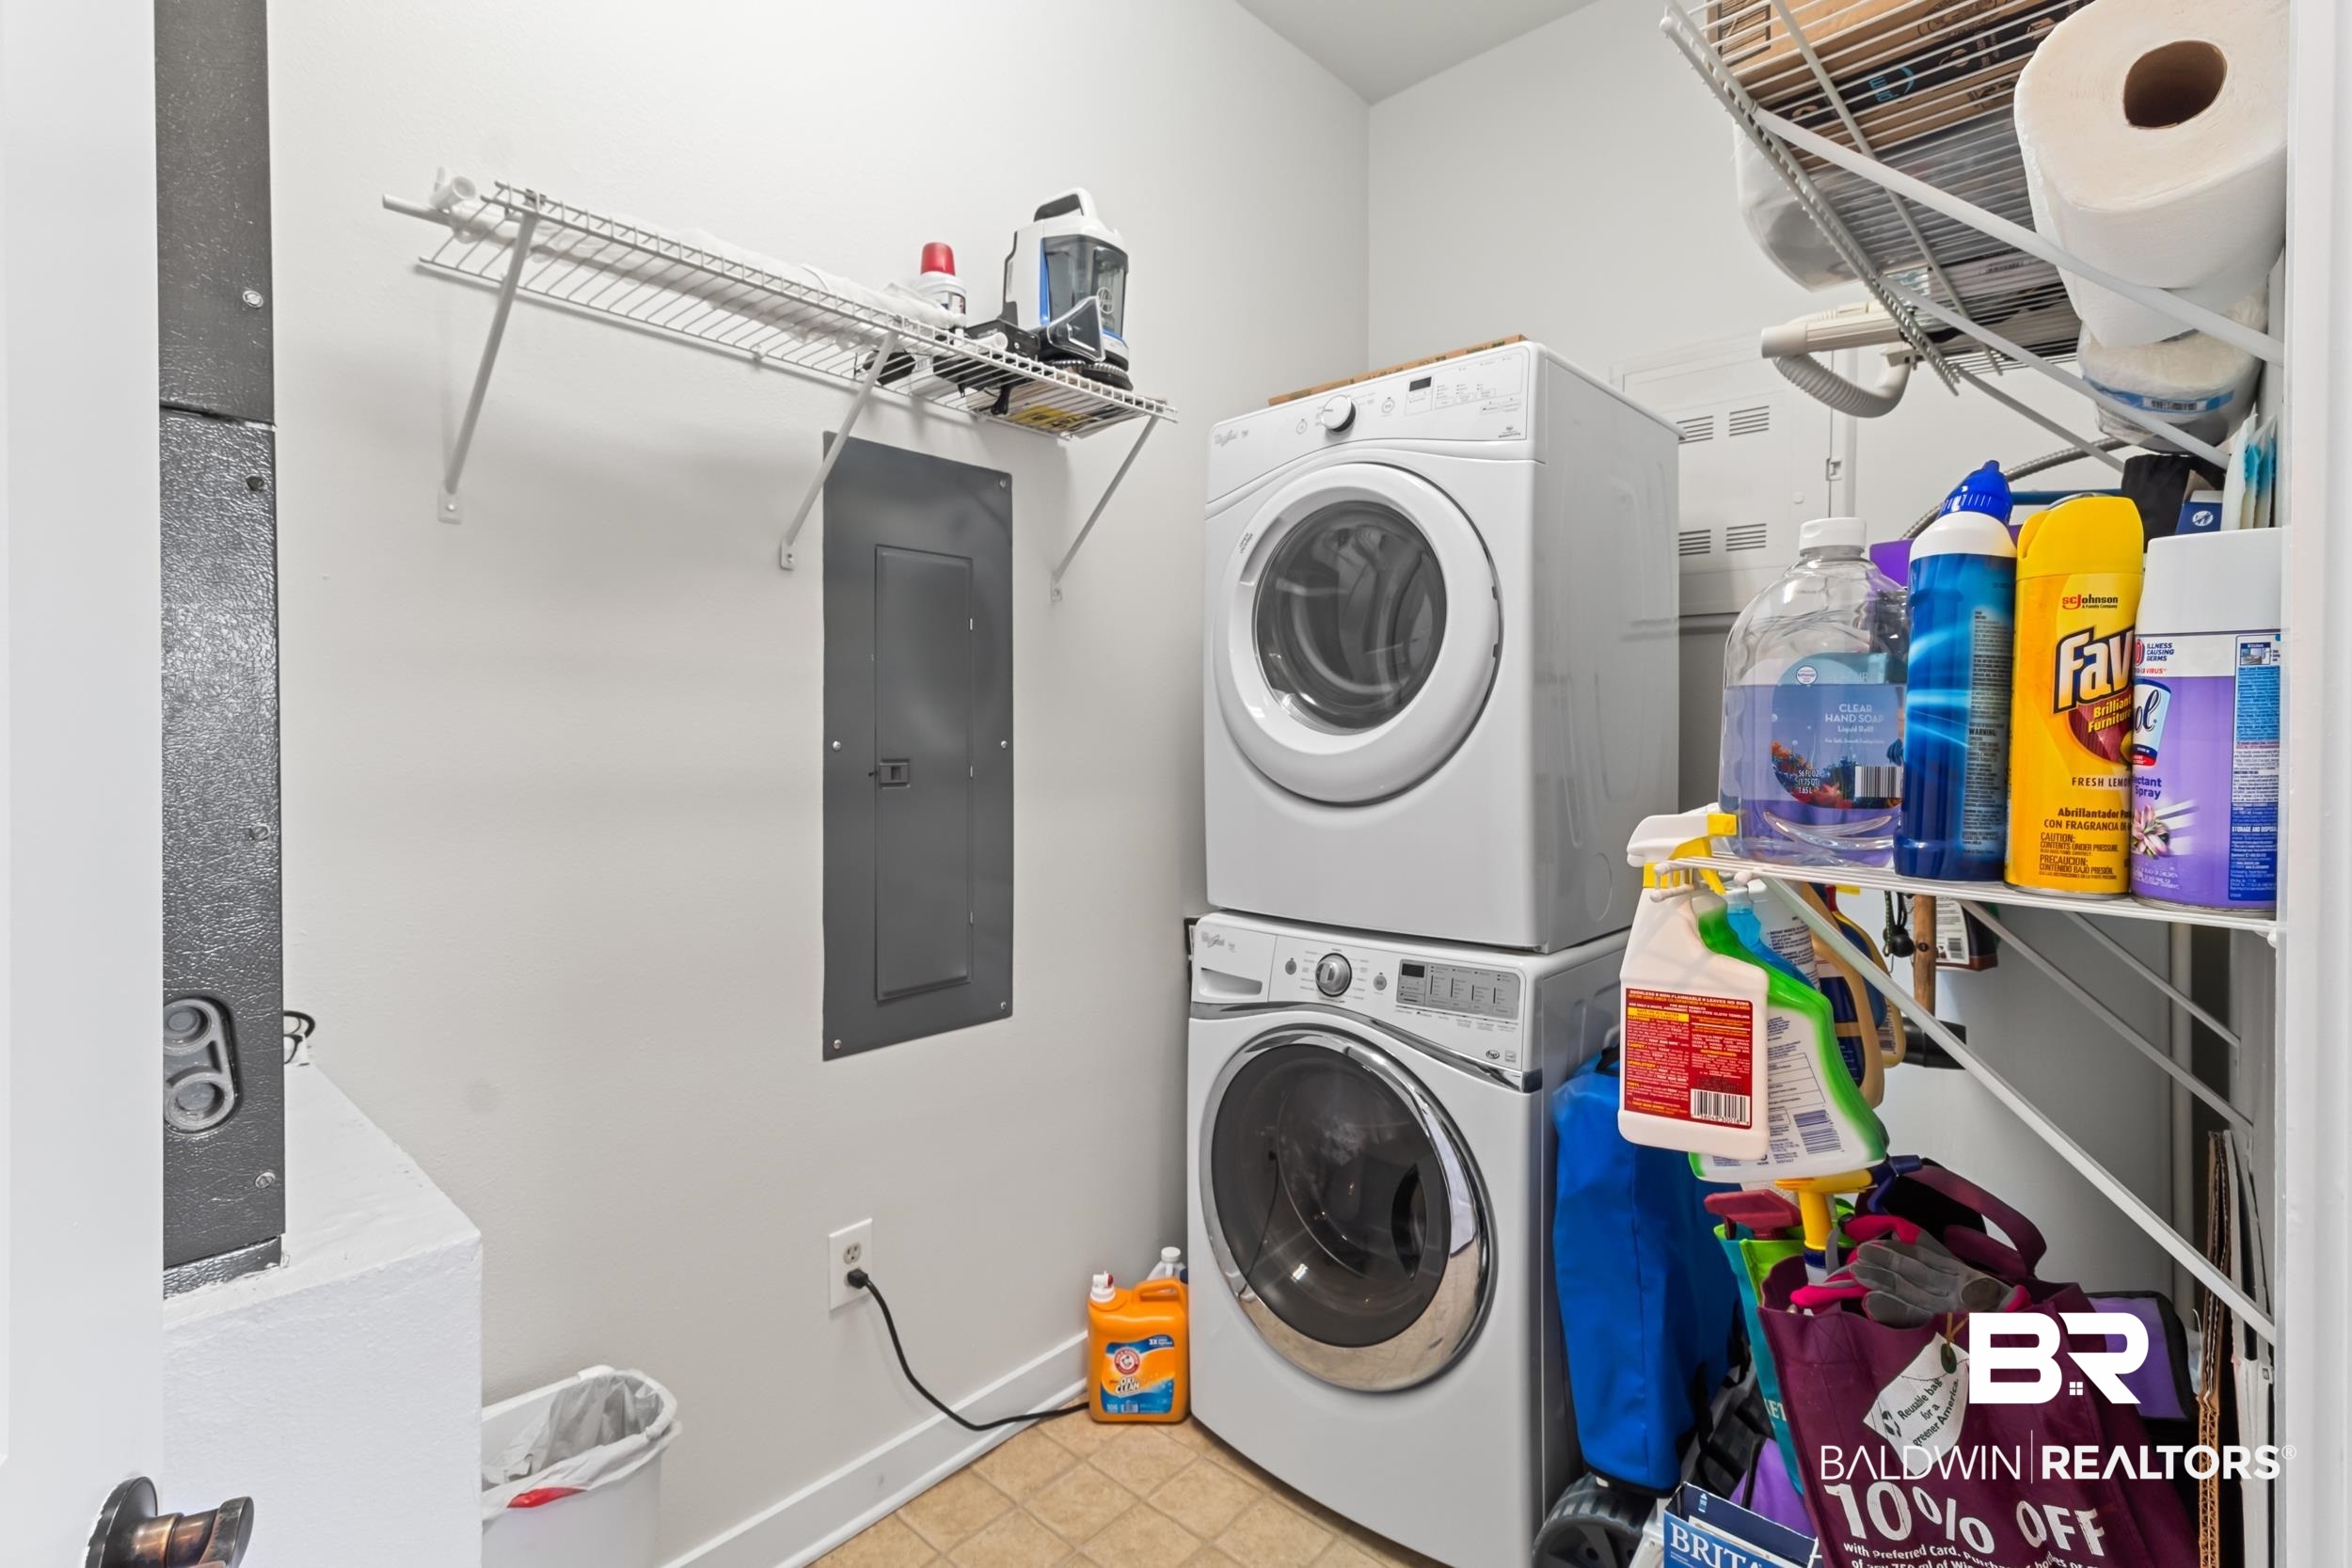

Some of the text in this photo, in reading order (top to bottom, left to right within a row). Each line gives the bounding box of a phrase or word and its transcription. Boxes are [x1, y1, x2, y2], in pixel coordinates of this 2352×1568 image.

[2057, 627, 2134, 711] Fav
[1838, 704, 1872, 713] CLEAR
[1825, 714, 1883, 723] HAND SOAP
[1837, 725, 1857, 734] Liquid
[2072, 777, 2105, 787] FRESH
[2135, 784, 2161, 800] Spray
[2058, 807, 2119, 818] Abrillantador
[2043, 818, 2063, 829] CON
[2065, 820, 2119, 832] FRAGRANCIA
[2040, 832, 2075, 844] CAUTION:
[2040, 841, 2071, 850] CONTENTS
[2072, 843, 2092, 851] UNDER
[2040, 854, 2089, 866] PRECAUCION:
[2039, 863, 2073, 873] CONTENIDO
[2073, 864, 2090, 874] BAJO
[1897, 1378, 1943, 1420] Reusable bag
[1913, 1379, 1960, 1448] greener America.
[1920, 1403, 1941, 1421] for a
[1823, 1481, 2106, 1557] 10% OFF
[1843, 1542, 1869, 1558] with
[1872, 1544, 1927, 1560] Preferred
[1930, 1545, 1962, 1558] Card.
